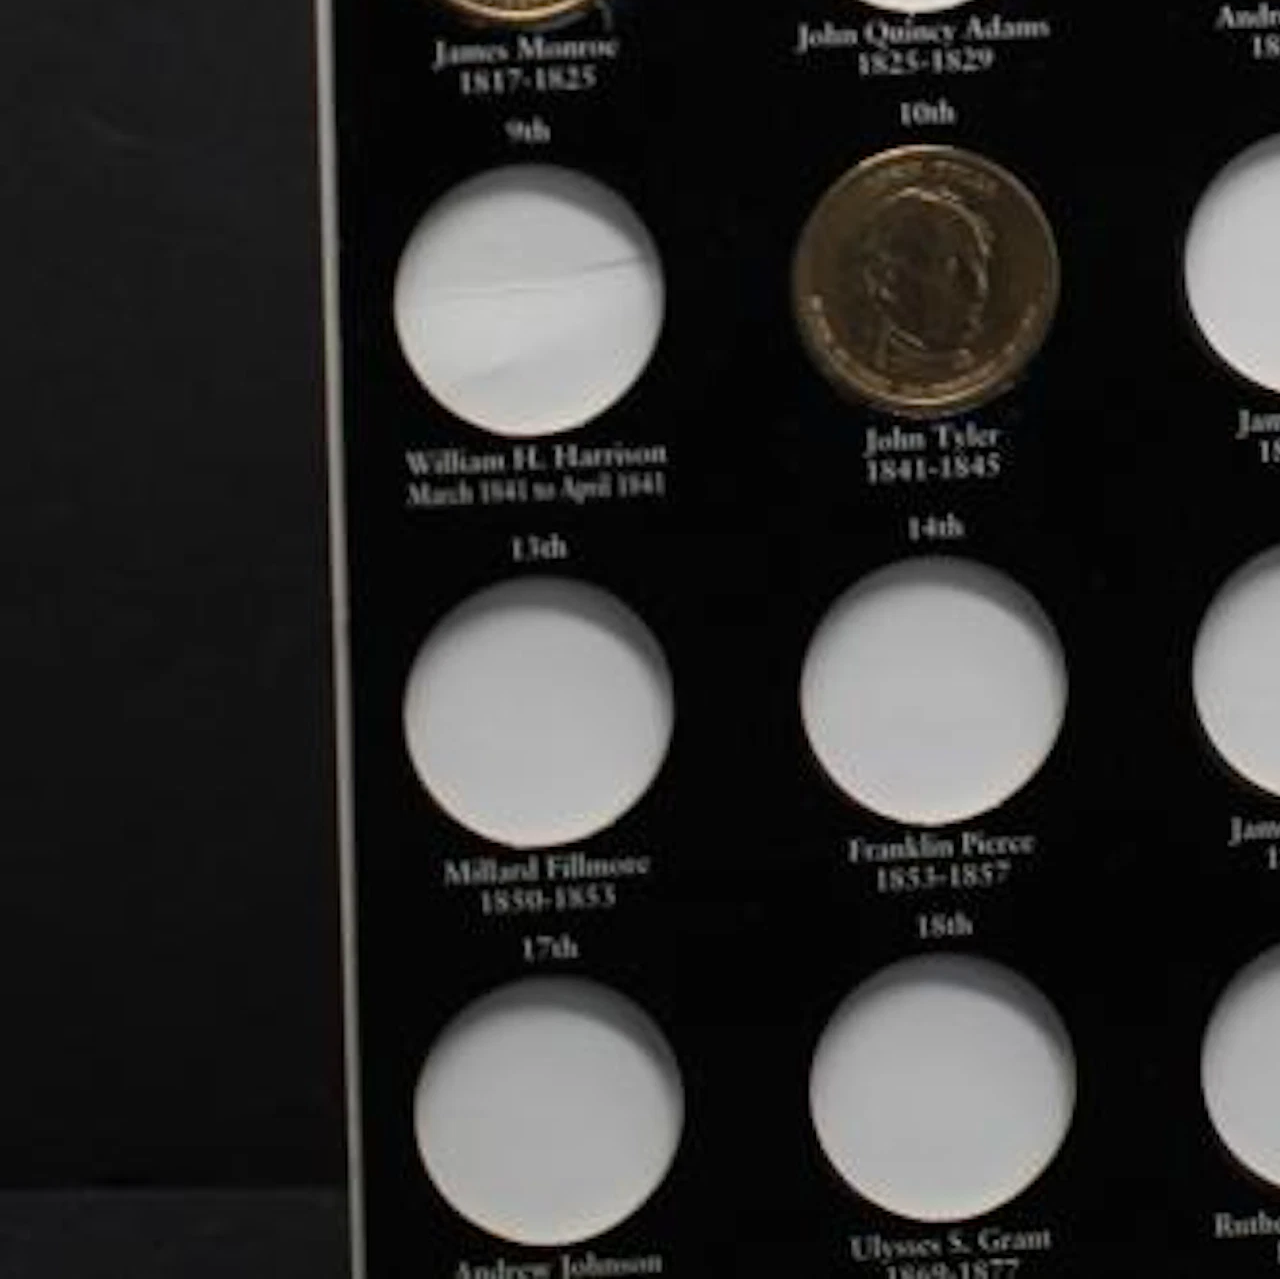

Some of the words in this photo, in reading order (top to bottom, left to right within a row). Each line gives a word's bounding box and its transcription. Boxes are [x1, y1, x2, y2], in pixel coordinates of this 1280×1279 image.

[798, 24, 857, 53] John
[863, 17, 960, 49] Quincy
[965, 15, 1050, 39] Adams
[432, 40, 508, 71] James
[515, 37, 619, 62] Monroe
[858, 47, 993, 76] 1825-1829
[460, 65, 596, 95] 1817-1825
[900, 100, 955, 125] 10th
[862, 428, 926, 459] John
[406, 450, 505, 476] William
[512, 447, 547, 471] H.
[555, 444, 666, 469] Harrison
[867, 454, 1000, 485] 1841-1845
[908, 514, 965, 540] 14th
[847, 837, 955, 863] Franklin
[962, 832, 1035, 858] Pierce
[443, 859, 538, 886] Millard
[546, 853, 651, 880] Fillmore
[876, 860, 1011, 892] 1853-1857
[918, 914, 973, 939] 18th
[522, 934, 579, 962] 17th
[851, 1234, 942, 1261] Ulysses
[947, 1232, 971, 1255] S.
[977, 1227, 1051, 1252] Grant
[560, 1253, 663, 1279] Johnson
